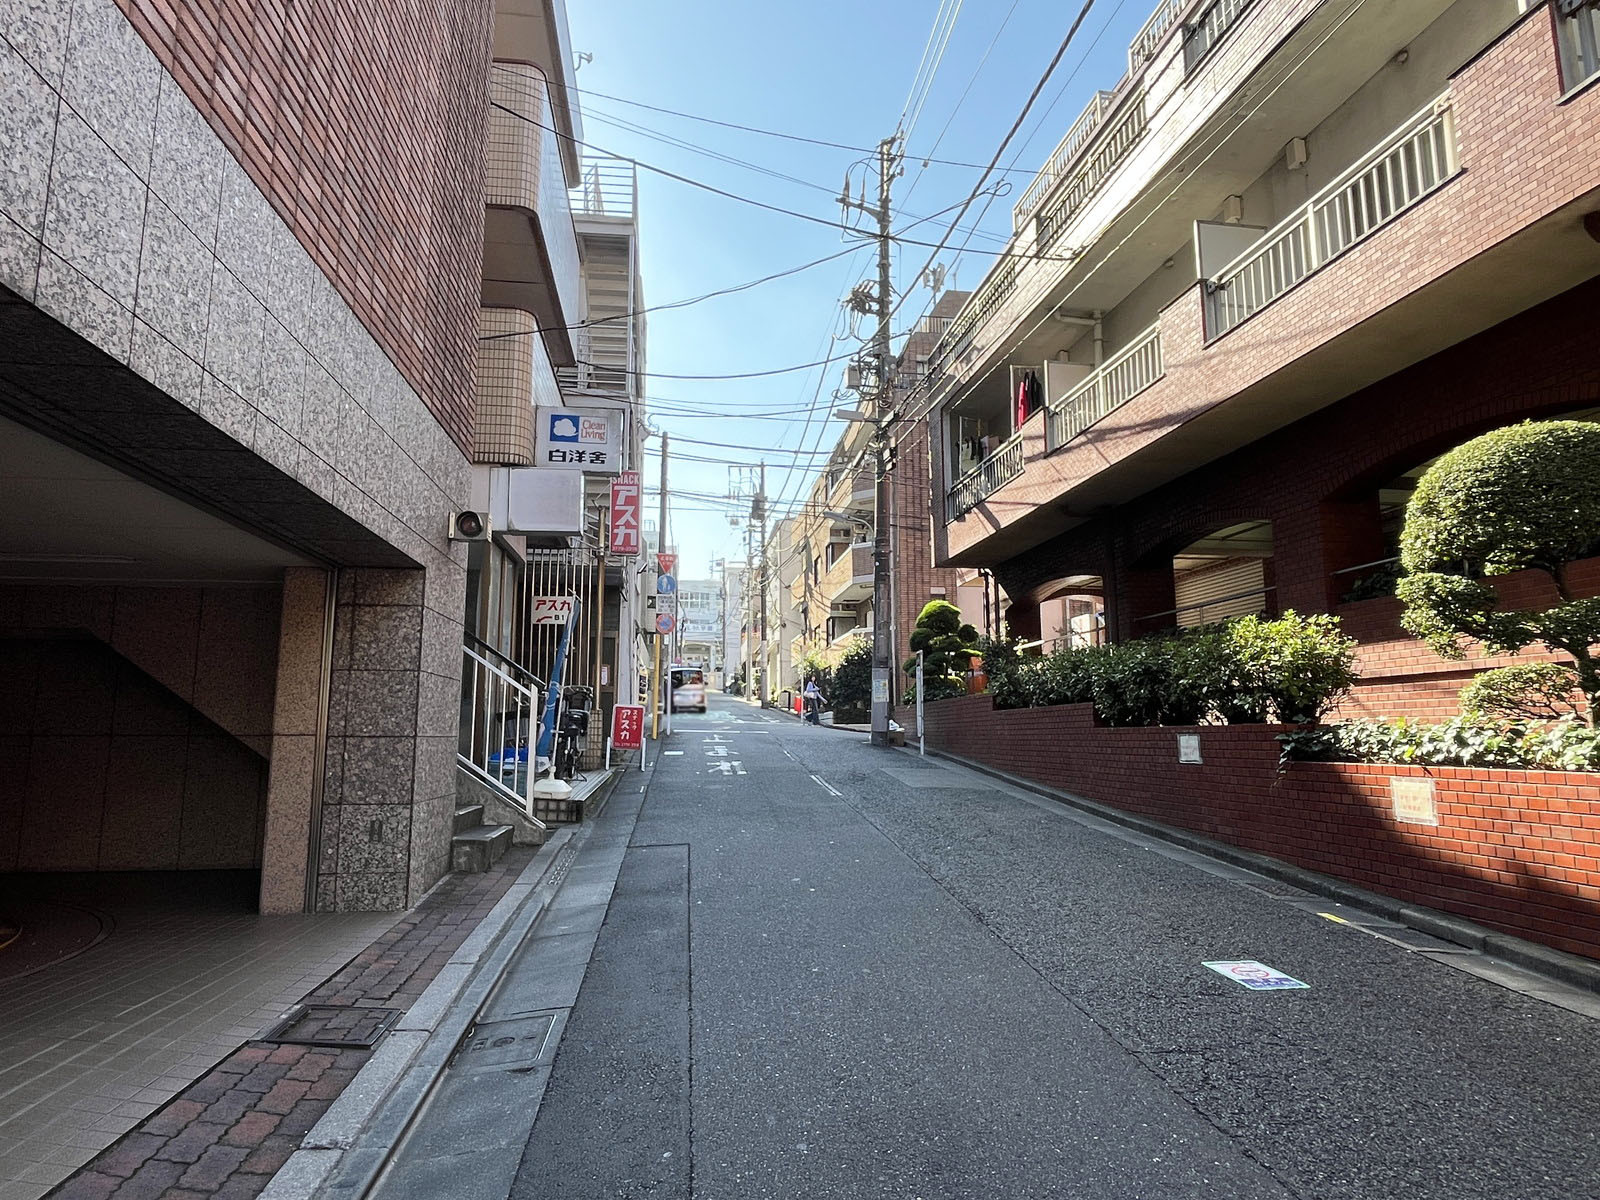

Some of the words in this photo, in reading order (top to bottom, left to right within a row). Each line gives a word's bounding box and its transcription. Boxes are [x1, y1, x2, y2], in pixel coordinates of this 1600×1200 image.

[582, 419, 606, 430] Clean
[581, 429, 606, 441] Living
[613, 485, 638, 546] アスカ
[535, 599, 572, 611] アスカ
[620, 709, 630, 740] アスカ
